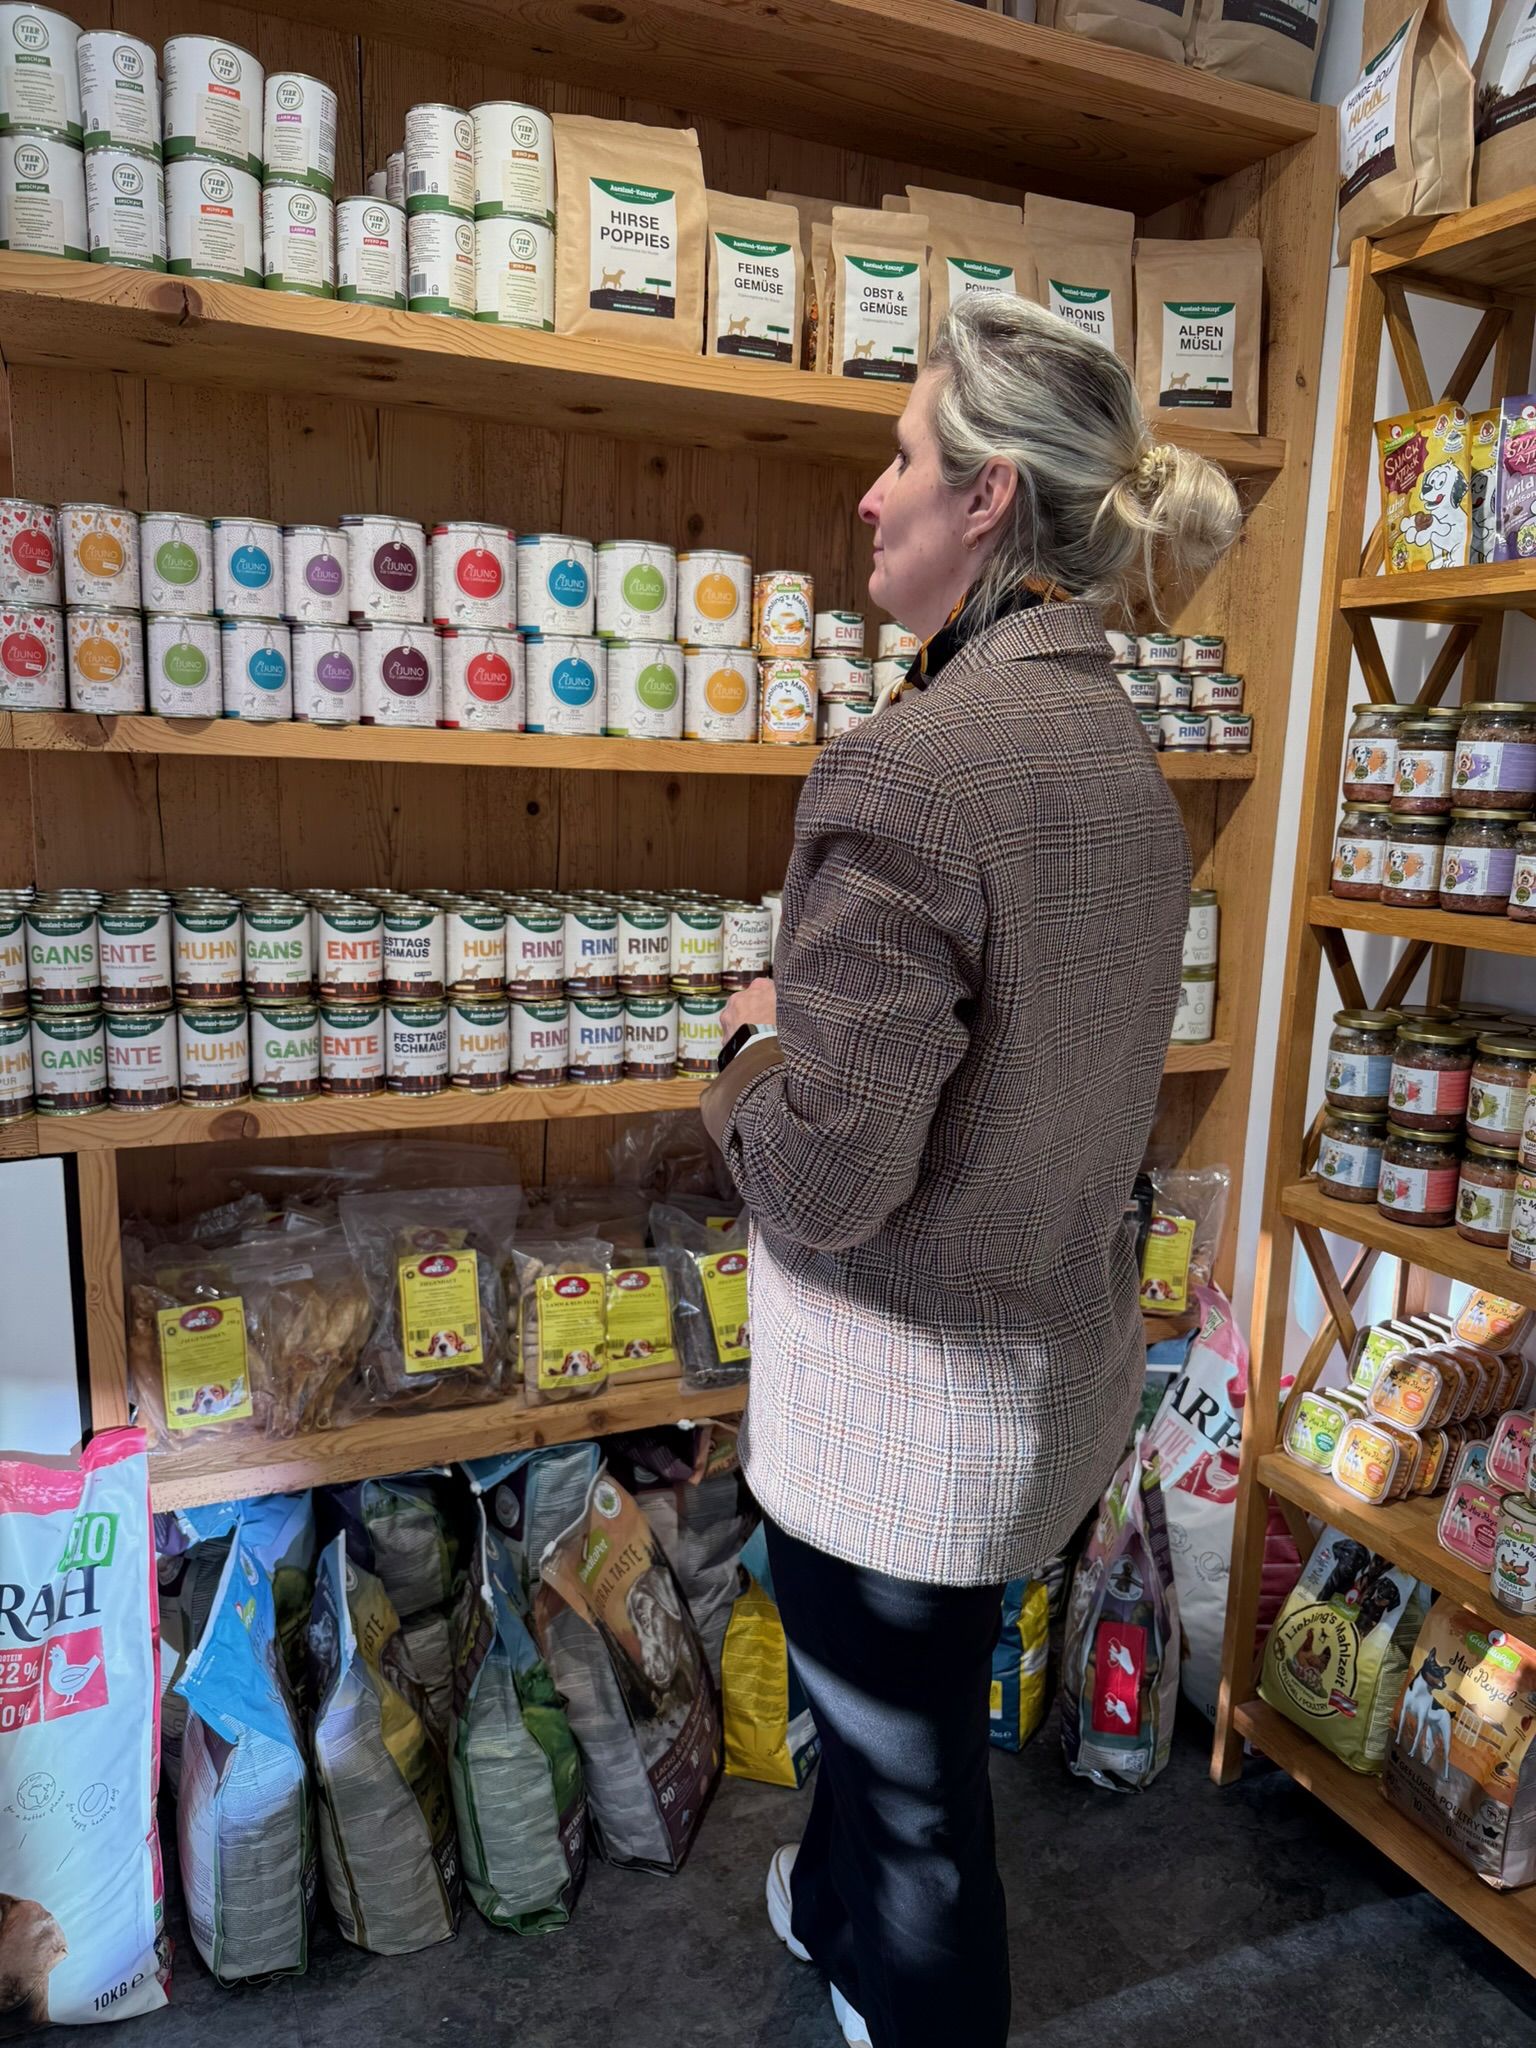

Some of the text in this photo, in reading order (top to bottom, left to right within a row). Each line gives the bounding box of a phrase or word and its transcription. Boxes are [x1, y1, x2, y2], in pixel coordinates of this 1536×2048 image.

[21, 25, 40, 34] TIER
[24, 35, 38, 43] FIT
[120, 54, 136, 64] TIER
[217, 57, 234, 70] TIER
[123, 63, 135, 72] FIT
[219, 68, 232, 76] FIT
[282, 89, 297, 97] TIER
[1349, 84, 1383, 132] HUHN
[518, 125, 532, 134] TIER
[520, 133, 531, 141] FIT
[21, 154, 40, 163] TIER
[24, 163, 38, 171] FIT
[119, 171, 136, 180] TIER
[208, 178, 225, 188] TIER
[122, 179, 134, 188] FIT
[211, 186, 223, 195] FIT
[610, 184, 659, 200] Auenland-Konzept
[295, 202, 310, 210] TIER
[369, 215, 384, 223] TIER
[611, 210, 660, 230] HIRSE
[516, 238, 531, 246] TIER
[600, 226, 670, 249] POPPIES
[738, 262, 779, 279] FEINES
[734, 276, 784, 296] GEMÜSE
[863, 287, 904, 301] OBST &
[860, 300, 908, 317] GEMÜSE
[1059, 305, 1106, 322] VRONIS
[1069, 319, 1101, 334] ÜSLI
[1179, 325, 1224, 338] ALPEN
[1180, 337, 1222, 351] MÜSLI
[1506, 476, 1535, 500] Wild
[835, 627, 864, 639] ENTE
[1150, 647, 1178, 658] RIND
[1195, 649, 1222, 660] RIND
[1212, 687, 1239, 698] RIND
[1179, 727, 1206, 737] RIND
[1224, 727, 1249, 737] RIND
[177, 940, 238, 958] HUHN
[247, 940, 303, 960] GANS
[383, 936, 431, 949] ESTTAGS
[463, 940, 504, 958] HUH
[522, 939, 563, 959] RIND
[628, 936, 669, 954] RIND
[680, 938, 721, 954] HUH
[31, 943, 94, 964] GANS
[101, 944, 157, 964] ENTE
[327, 941, 381, 960] ENTE
[393, 1031, 447, 1044] FESTTAGS
[530, 1031, 568, 1049] RIND
[580, 1026, 623, 1044] RIND
[626, 1025, 669, 1043] RIND
[186, 1040, 246, 1062] HUHN
[265, 1039, 319, 1058] GANS
[323, 1034, 379, 1056] ENTE
[394, 1041, 447, 1053] SCHMAUS
[636, 1043, 655, 1051] PUR
[41, 1046, 104, 1069] GANS
[108, 1046, 162, 1066] ENTE
[610, 1543, 643, 1582] TASTE
[1284, 1611, 1338, 1641] Liebling's
[1334, 1621, 1351, 1689] Mahlzeit
[1449, 1651, 1518, 1706] Mini Royal
[660, 1786, 676, 1809] 90
[1440, 1796, 1480, 1830] POULTRY
[93, 1981, 128, 2011] 10KG
